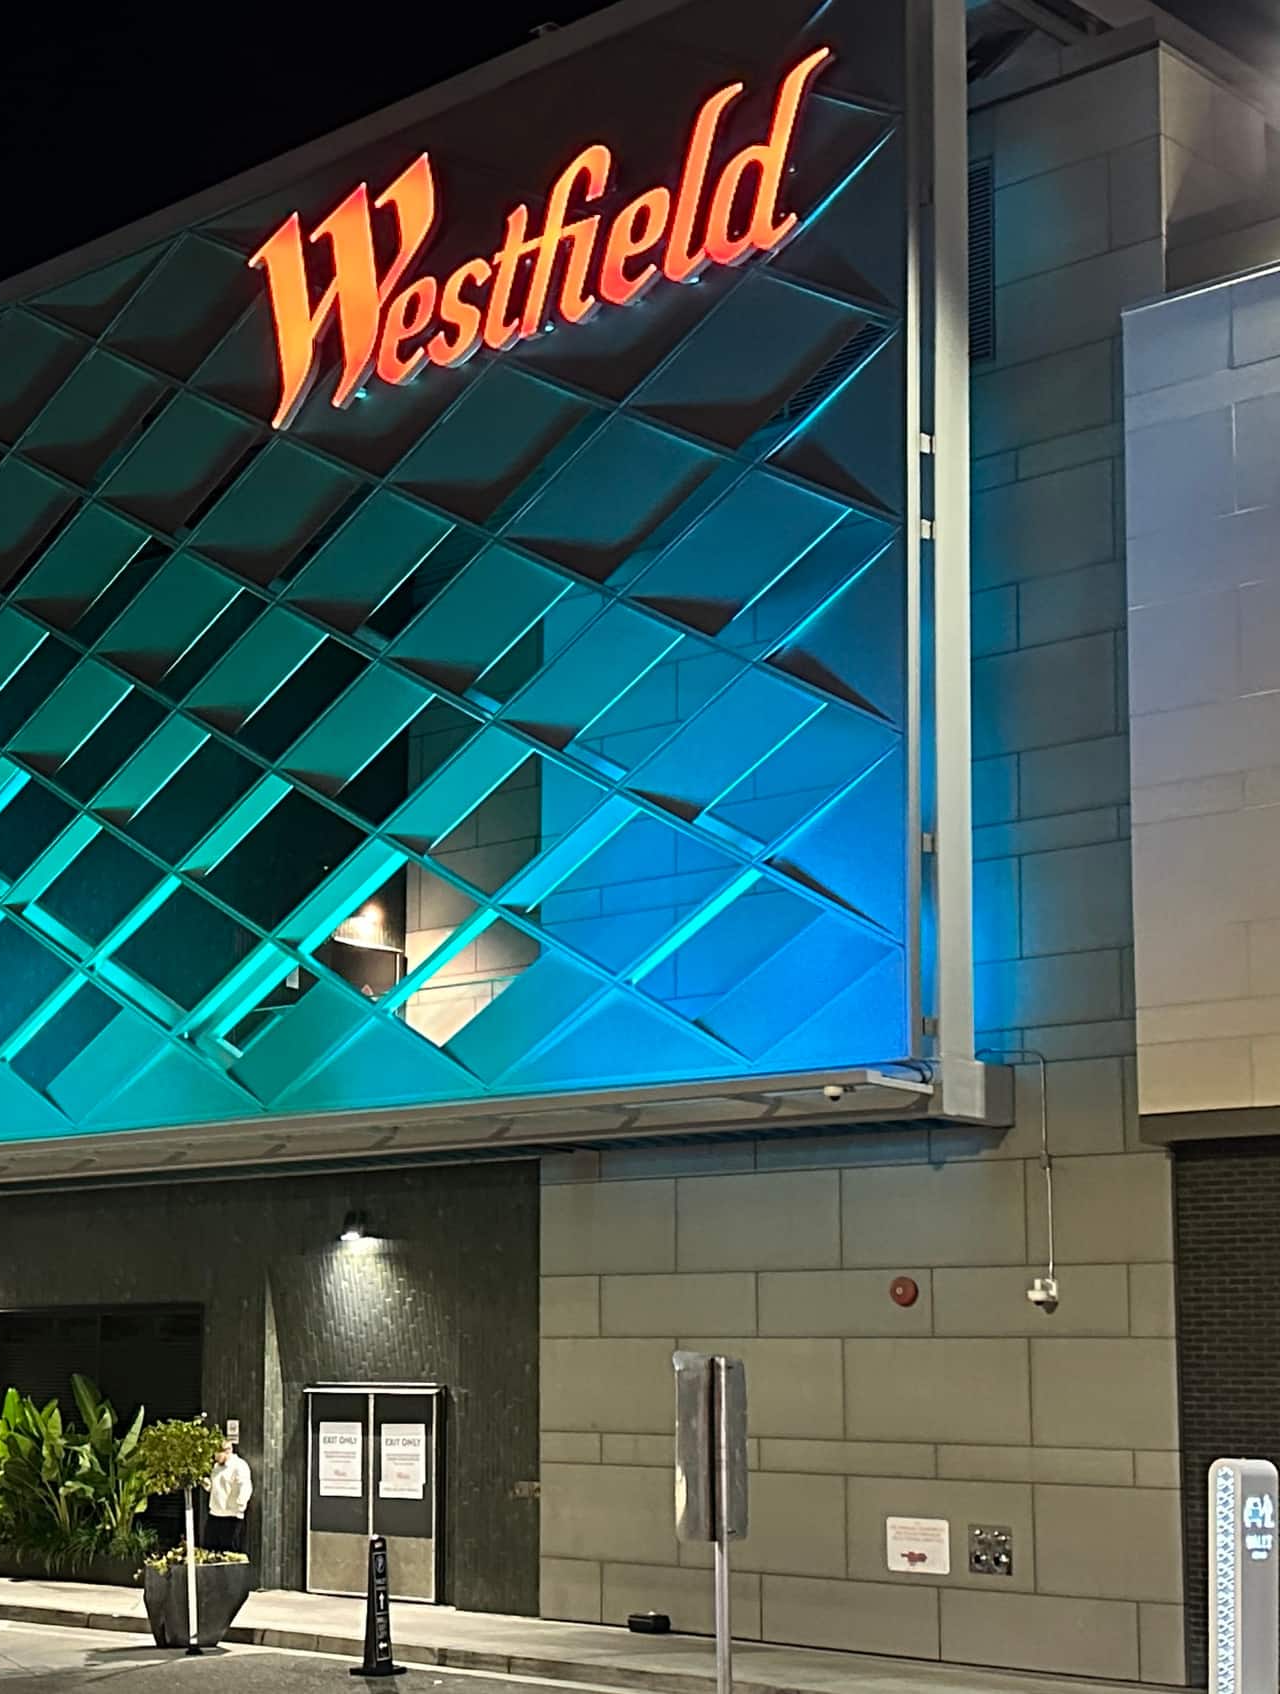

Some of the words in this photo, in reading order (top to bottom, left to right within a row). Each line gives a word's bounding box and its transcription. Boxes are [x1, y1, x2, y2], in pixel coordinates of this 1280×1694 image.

[247, 46, 830, 430] Westfield
[323, 1436, 338, 1445] EXIT
[339, 1436, 358, 1445] ONLY
[385, 1438, 400, 1447] EXIT
[401, 1438, 421, 1447] ONLY
